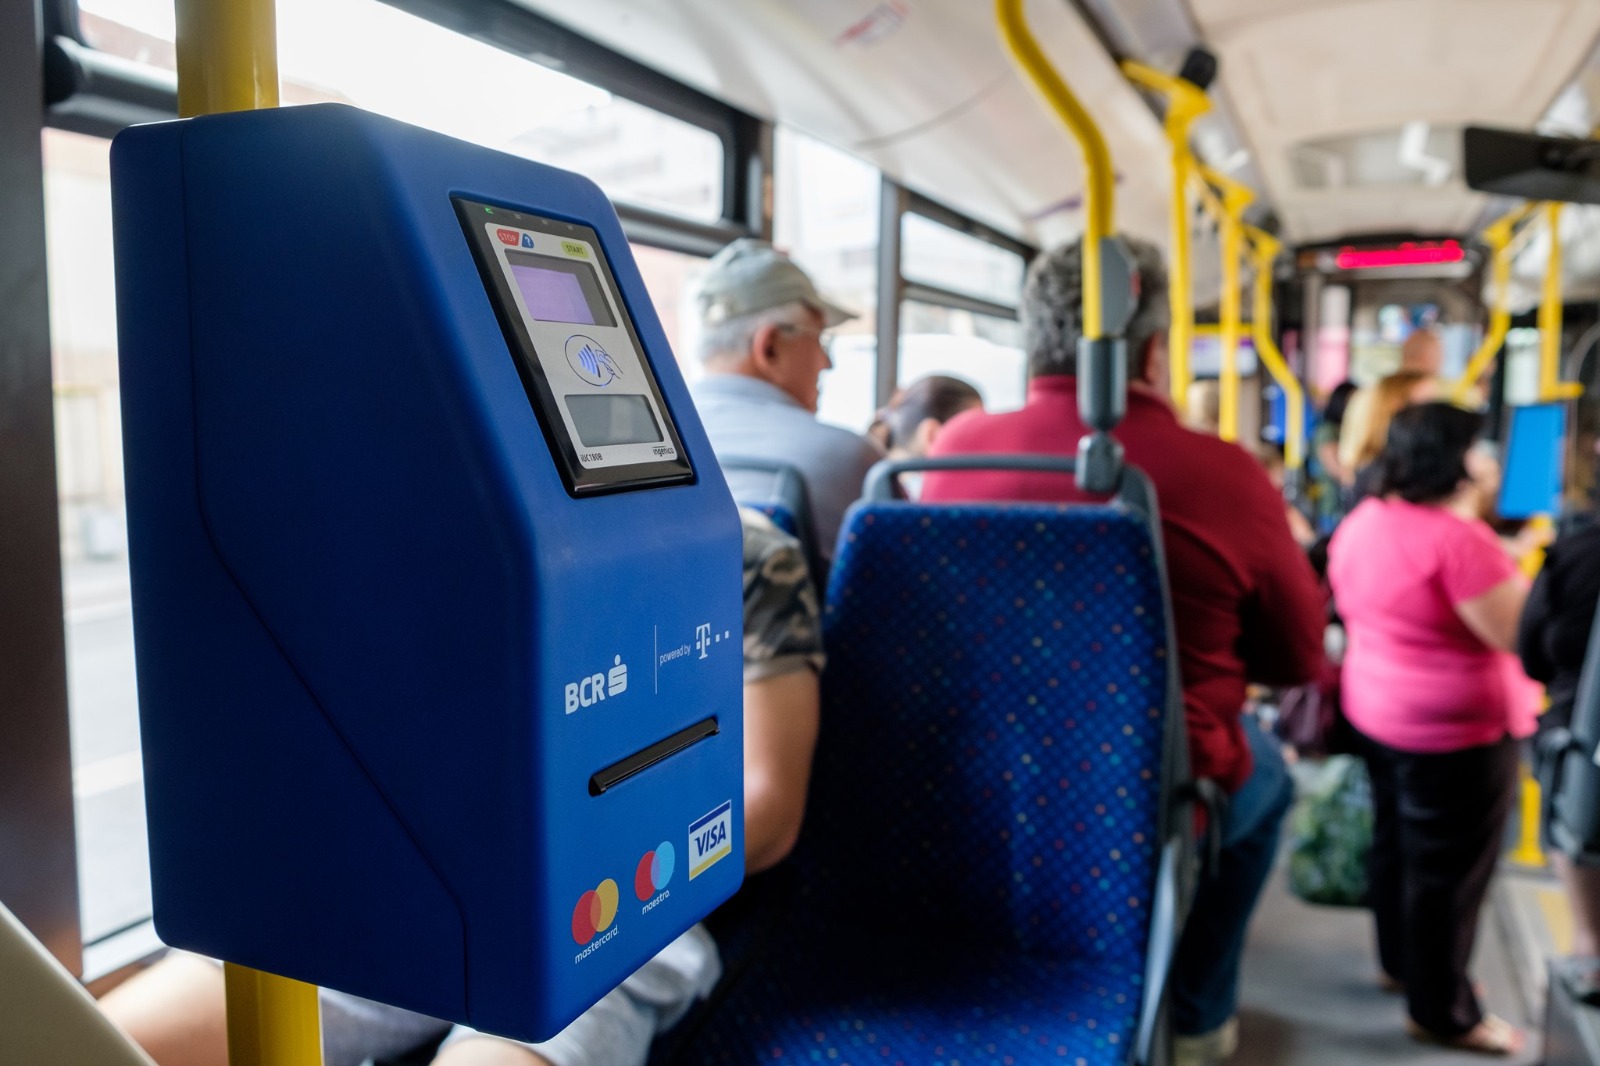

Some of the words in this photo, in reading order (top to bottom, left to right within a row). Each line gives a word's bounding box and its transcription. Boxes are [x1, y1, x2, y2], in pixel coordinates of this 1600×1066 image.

[498, 232, 517, 243] STOP
[566, 245, 584, 255] START
[653, 447, 674, 457] ingenico
[660, 645, 684, 666] powered
[684, 644, 691, 657] by
[565, 672, 605, 715] BCR
[694, 820, 727, 857] VISA
[642, 889, 670, 915] maestro
[574, 925, 619, 964] mastercard
